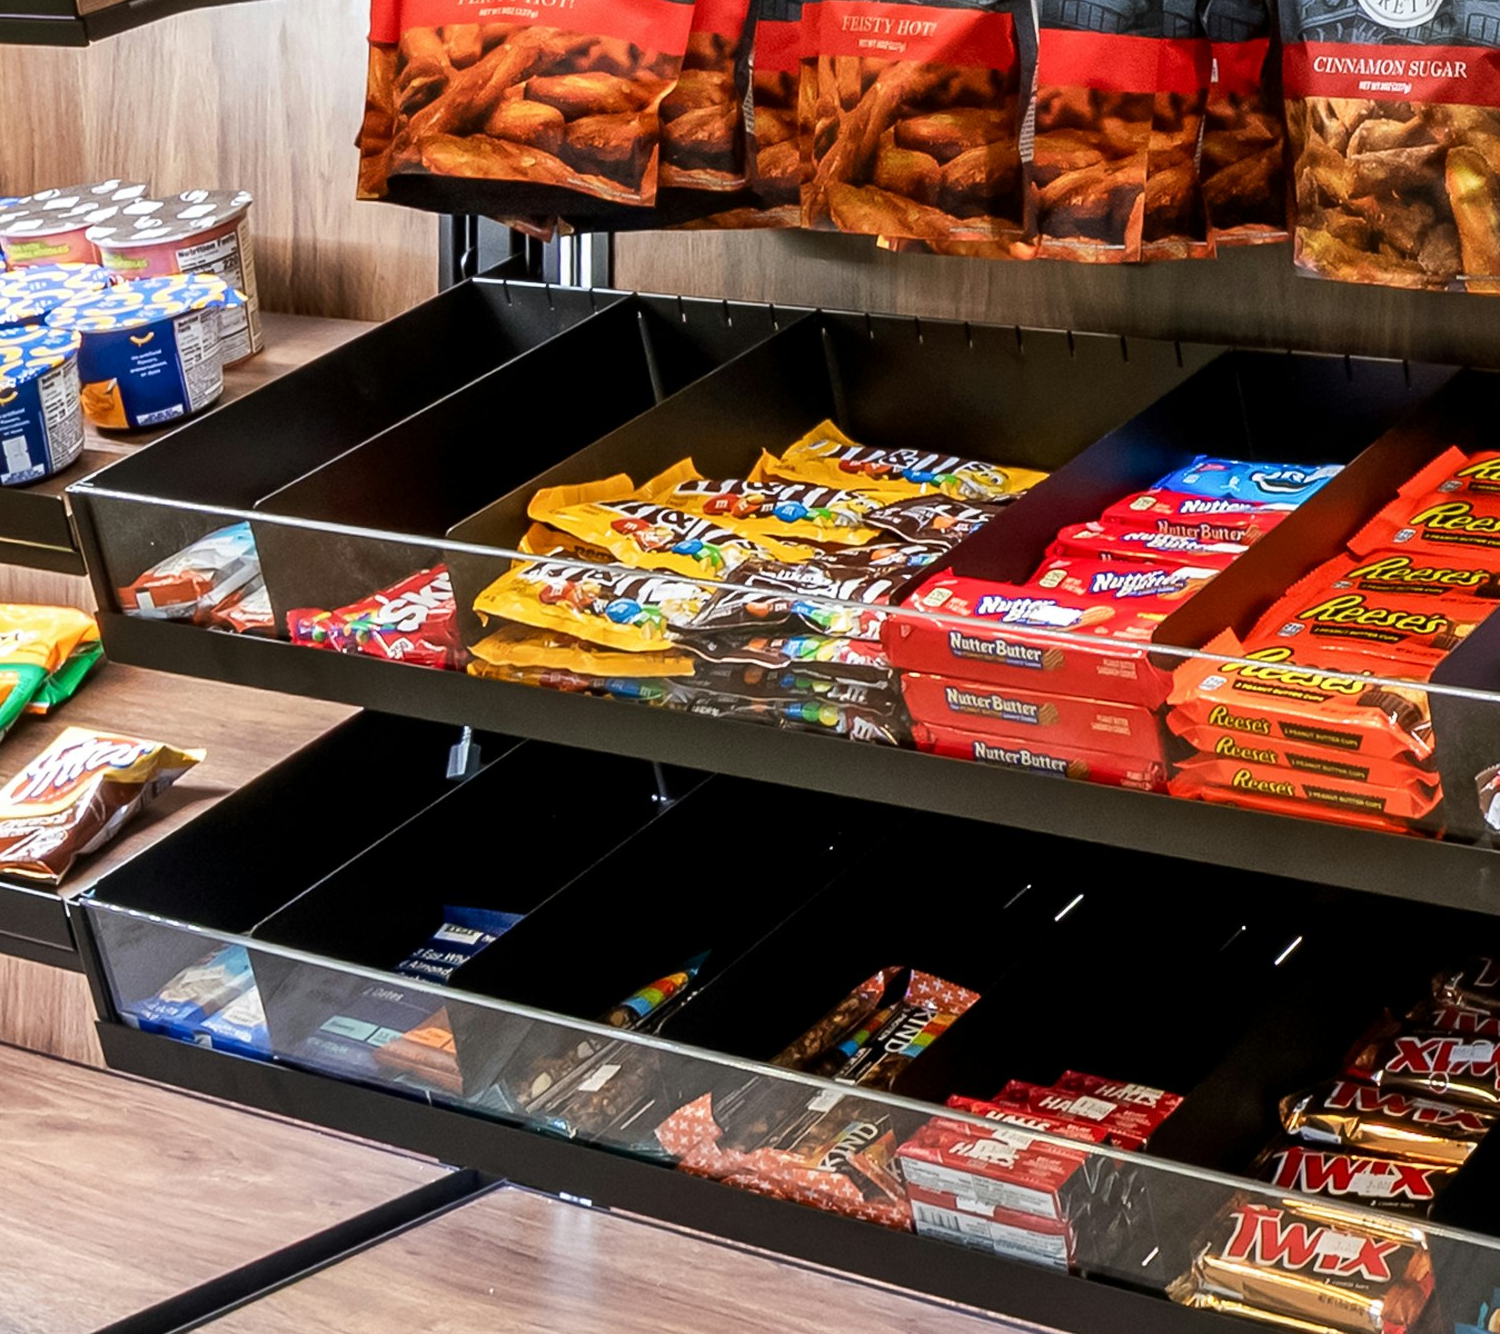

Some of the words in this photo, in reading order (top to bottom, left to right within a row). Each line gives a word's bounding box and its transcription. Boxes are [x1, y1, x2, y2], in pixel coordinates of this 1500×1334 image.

[1313, 55, 1406, 77] CINNAMON
[1408, 59, 1467, 79] SUGAR
[1296, 595, 1447, 634] Reese's
[1208, 705, 1271, 736] Reese's
[1233, 769, 1296, 797] Reese's
[818, 1122, 879, 1172] KIND
